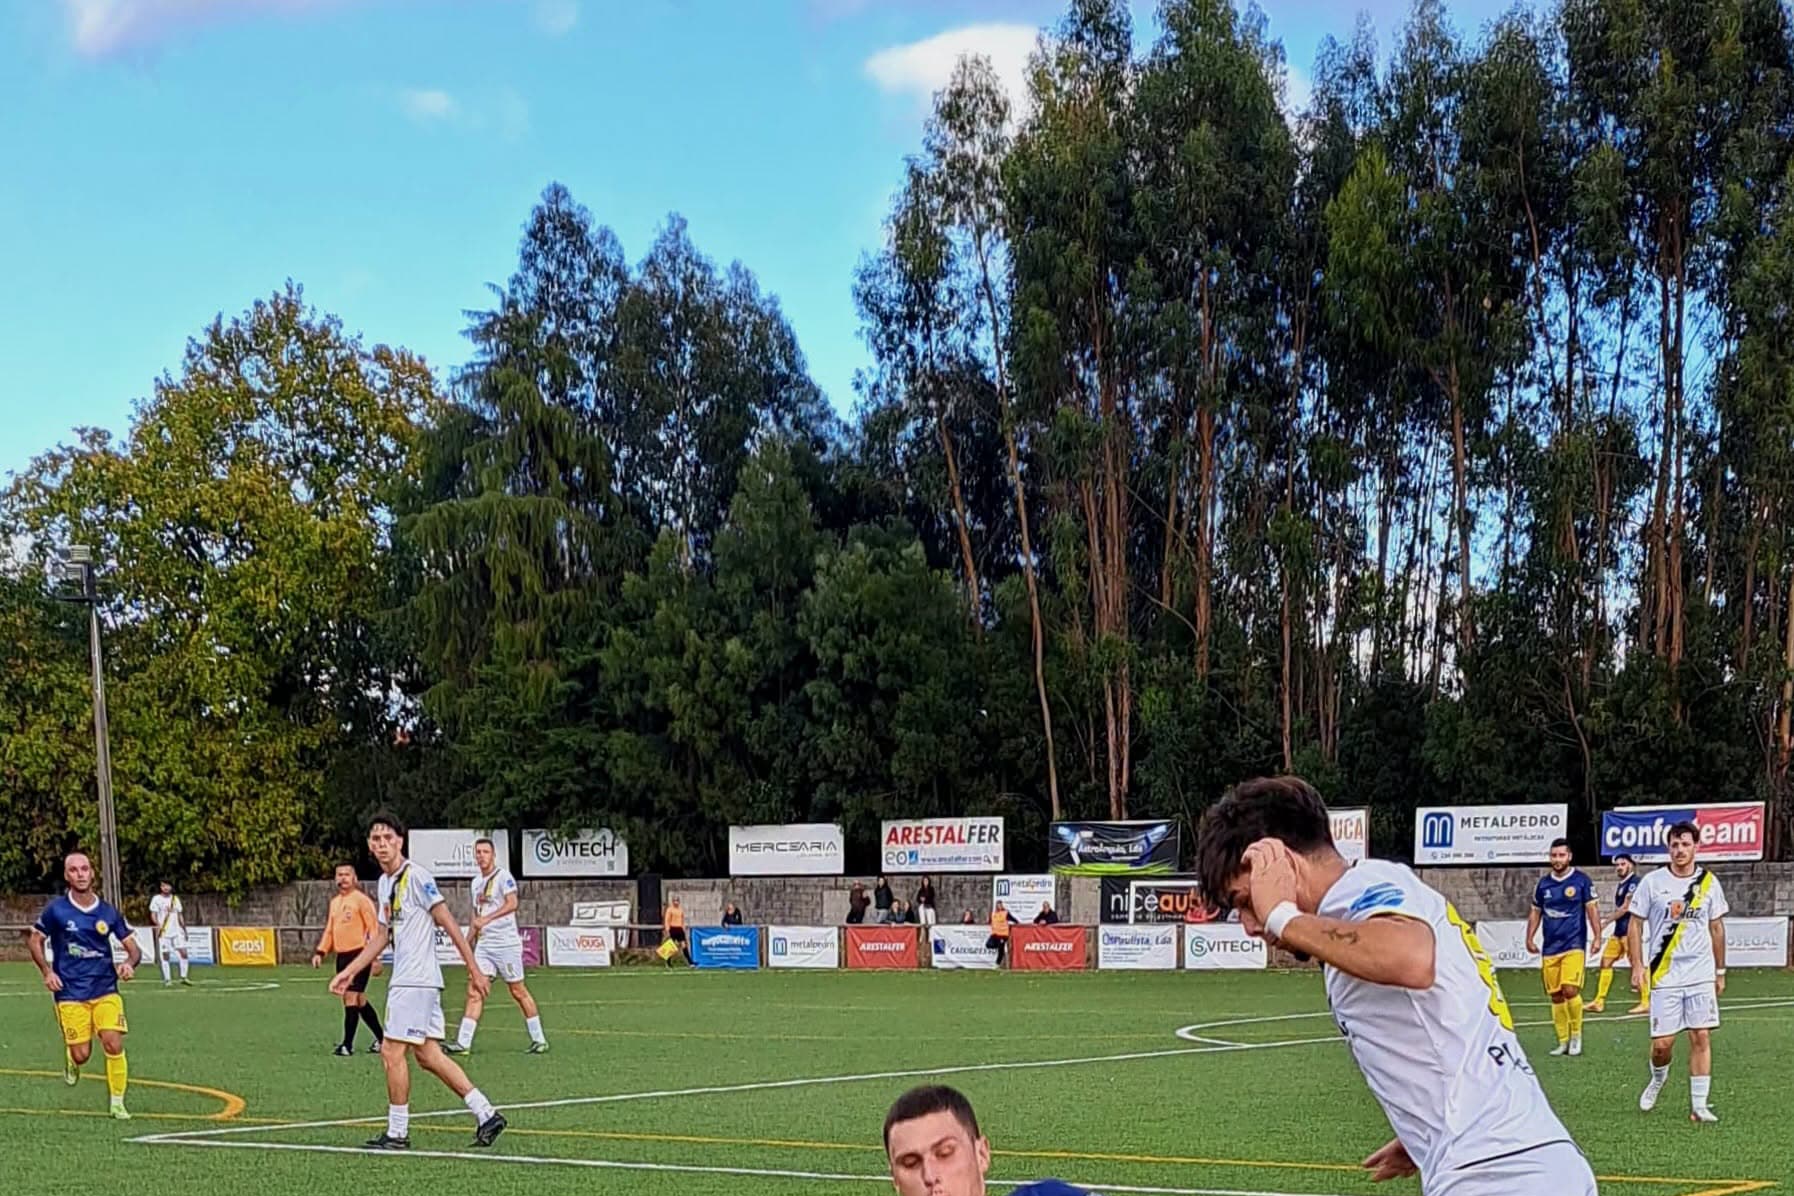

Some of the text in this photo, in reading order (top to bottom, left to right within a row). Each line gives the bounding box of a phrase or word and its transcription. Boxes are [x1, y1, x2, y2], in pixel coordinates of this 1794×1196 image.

[1460, 814, 1560, 829] METALPEDRO
[886, 824, 1000, 845] ARESTALFER
[736, 841, 837, 853] MERCEARIA
